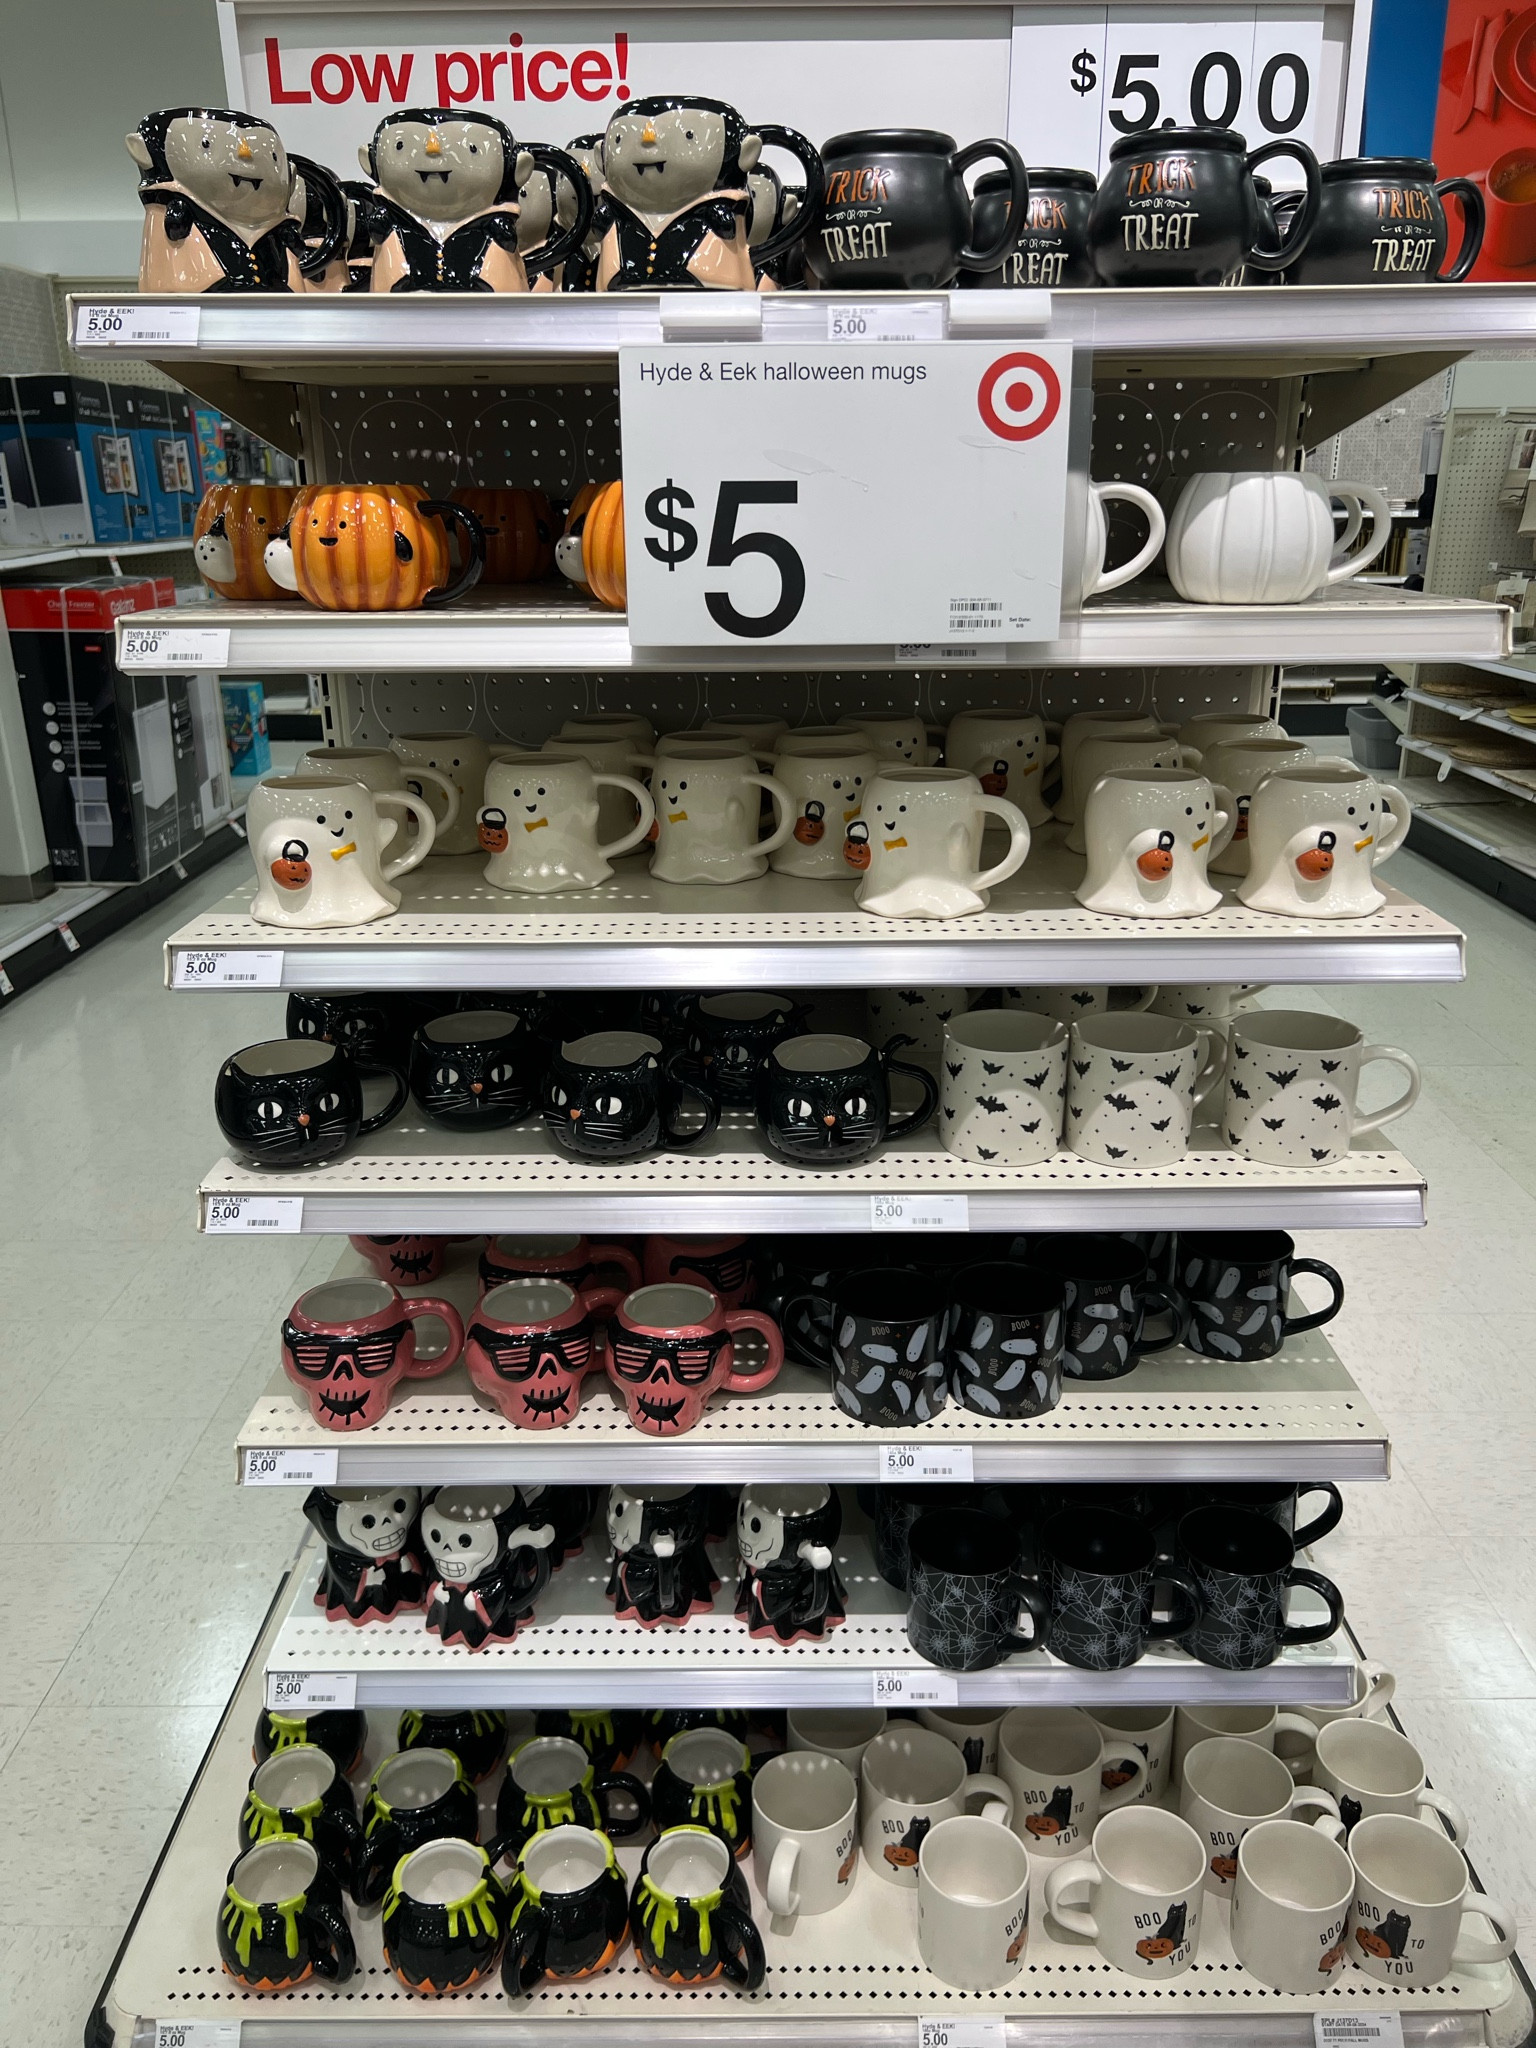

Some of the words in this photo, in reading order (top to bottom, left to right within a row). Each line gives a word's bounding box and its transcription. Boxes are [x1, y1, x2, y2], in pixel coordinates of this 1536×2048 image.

[264, 37, 414, 104] Low
[436, 33, 632, 109] price!
[1126, 156, 1198, 197] TRICK
[825, 168, 892, 205] TRICK
[1154, 198, 1164, 208] OR
[1373, 187, 1434, 222] TRICK
[847, 209, 857, 220] OR
[1120, 212, 1199, 251] TREAT
[821, 222, 892, 263] TREAT
[1372, 238, 1436, 273] TREAT
[89, 308, 108, 316] Hyde
[88, 318, 122, 331] 5.00
[833, 319, 867, 334] 5.00
[639, 362, 692, 386] Hyde
[698, 362, 713, 381] &
[720, 362, 757, 381] Eek
[764, 361, 864, 381] halloween
[871, 365, 927, 385] mugs
[644, 478, 806, 638] $5
[127, 630, 144, 638] Hyde
[126, 640, 158, 652] 5.00
[187, 952, 203, 960] Hyde
[185, 962, 216, 973] 5.00
[211, 1207, 240, 1218] 5.00
[875, 1205, 903, 1216] 5.00
[871, 1326, 890, 1336] BOOO
[1011, 1320, 1031, 1331] BOOO
[250, 1451, 265, 1459] Hyde
[888, 1455, 914, 1467] 5.00
[250, 1460, 276, 1471] 5.00
[276, 1683, 301, 1694] 5.00
[877, 1680, 902, 1692] 5.00
[1149, 1759, 1159, 1770] TO
[1023, 1790, 1047, 1805] BOO
[1074, 1802, 1085, 1814] TO
[881, 1819, 904, 1834] BOO
[836, 1829, 853, 1857] BOO
[1055, 1826, 1079, 1846] YOU
[1210, 1830, 1235, 1846] BOO
[1357, 1900, 1380, 1922] BOO
[1005, 1908, 1023, 1936] BOO
[1134, 1911, 1161, 1929] BOO
[1188, 1913, 1197, 1929] TO
[1319, 1920, 1342, 1946] BOO
[1411, 1939, 1425, 1950] TO
[1169, 1941, 1191, 1966] YOU
[1384, 1960, 1414, 1976] YOU
[160, 2034, 185, 2047] 5.00
[923, 2033, 948, 2045] 5.00
